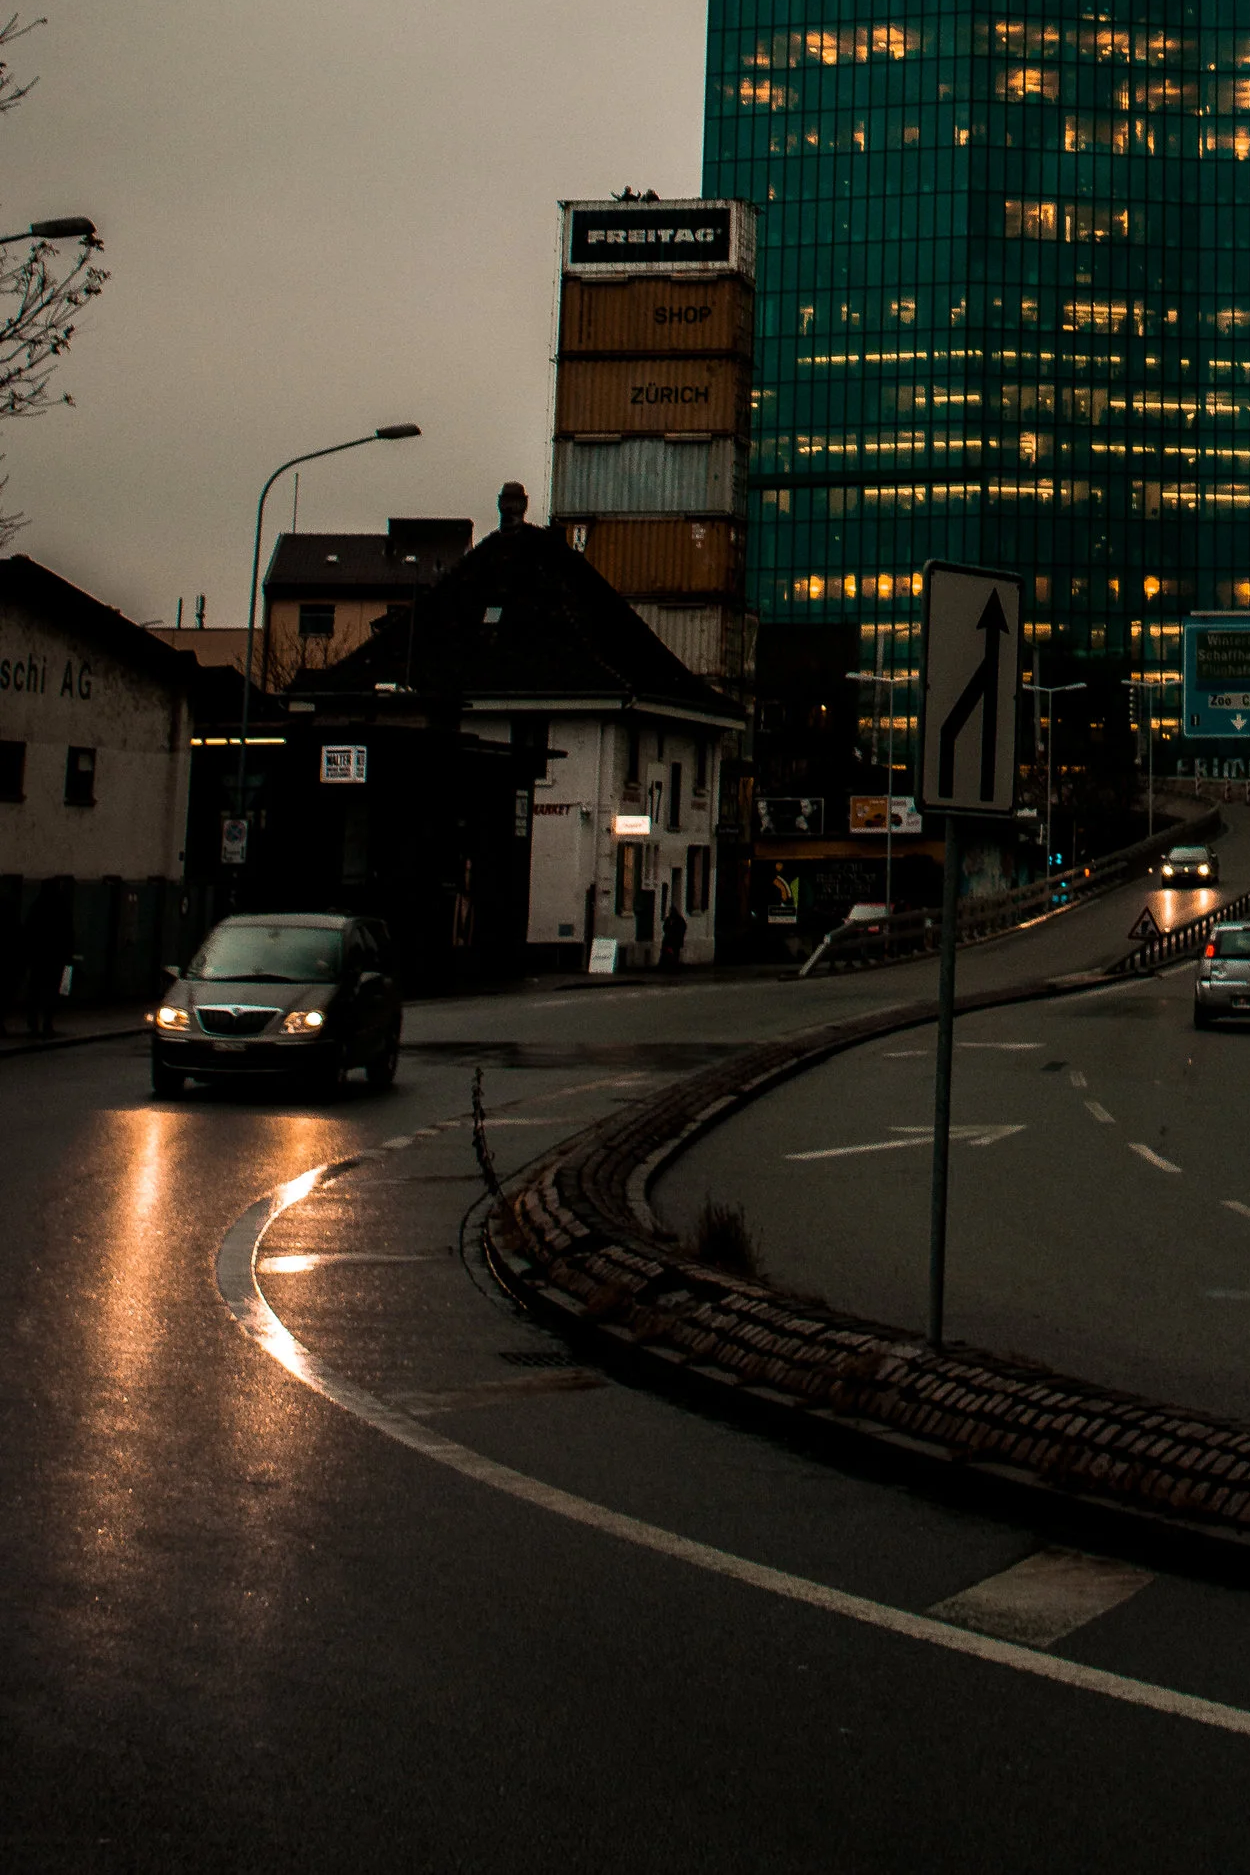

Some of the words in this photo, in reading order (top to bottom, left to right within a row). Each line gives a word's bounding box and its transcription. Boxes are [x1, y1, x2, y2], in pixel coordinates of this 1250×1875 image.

[587, 227, 716, 245] FREITAG
[654, 306, 712, 324] SHOP
[630, 382, 709, 404] ZÜRICH
[60, 659, 93, 700] AG
[1210, 694, 1232, 706] Zoo
